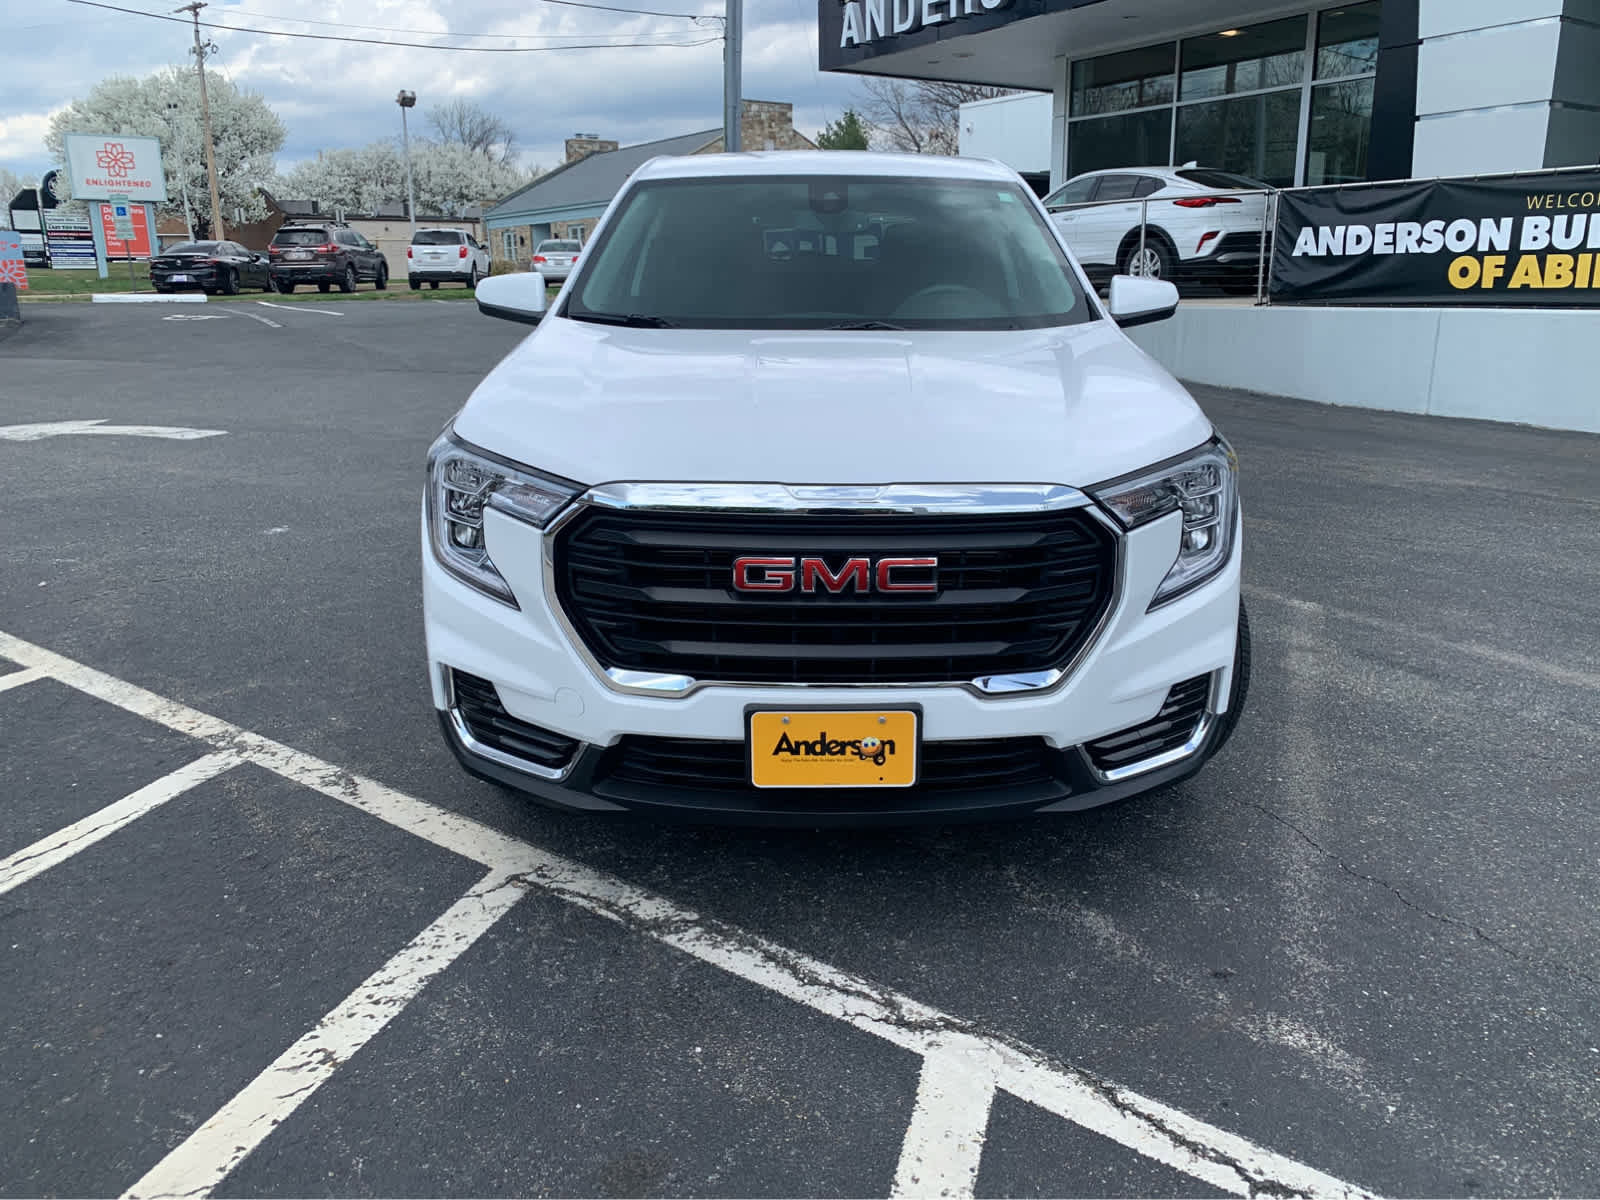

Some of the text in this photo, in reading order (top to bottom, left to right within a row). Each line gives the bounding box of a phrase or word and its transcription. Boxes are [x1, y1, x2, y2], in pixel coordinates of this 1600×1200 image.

[840, 0, 1000, 48] ANDE
[1527, 191, 1600, 210] WELCO
[1292, 217, 1513, 257] ANDERSON
[1448, 255, 1506, 289] OF
[733, 557, 938, 593] GMC
[772, 731, 896, 757] Anderson
